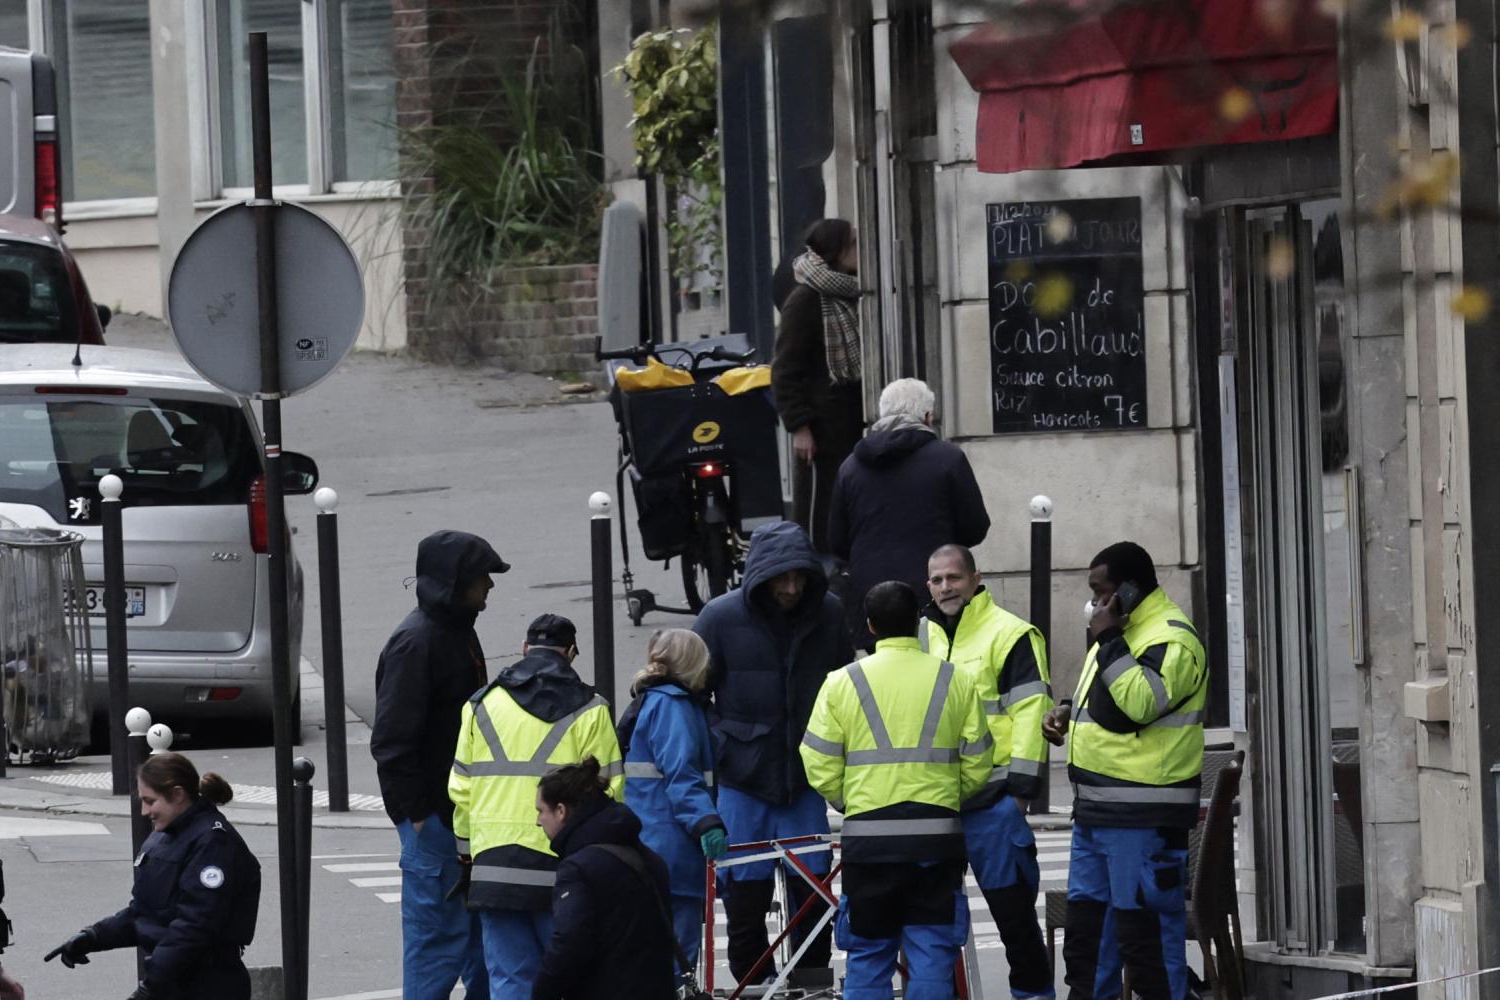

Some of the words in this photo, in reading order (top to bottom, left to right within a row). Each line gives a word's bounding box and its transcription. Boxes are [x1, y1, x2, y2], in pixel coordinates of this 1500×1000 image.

[992, 222, 1046, 256] PLAT
[1087, 277, 1114, 307] de
[993, 311, 1143, 356] Cabillaud
[997, 363, 1045, 387] Sauce
[1056, 364, 1114, 388] citron
[1033, 410, 1101, 428] Haricots
